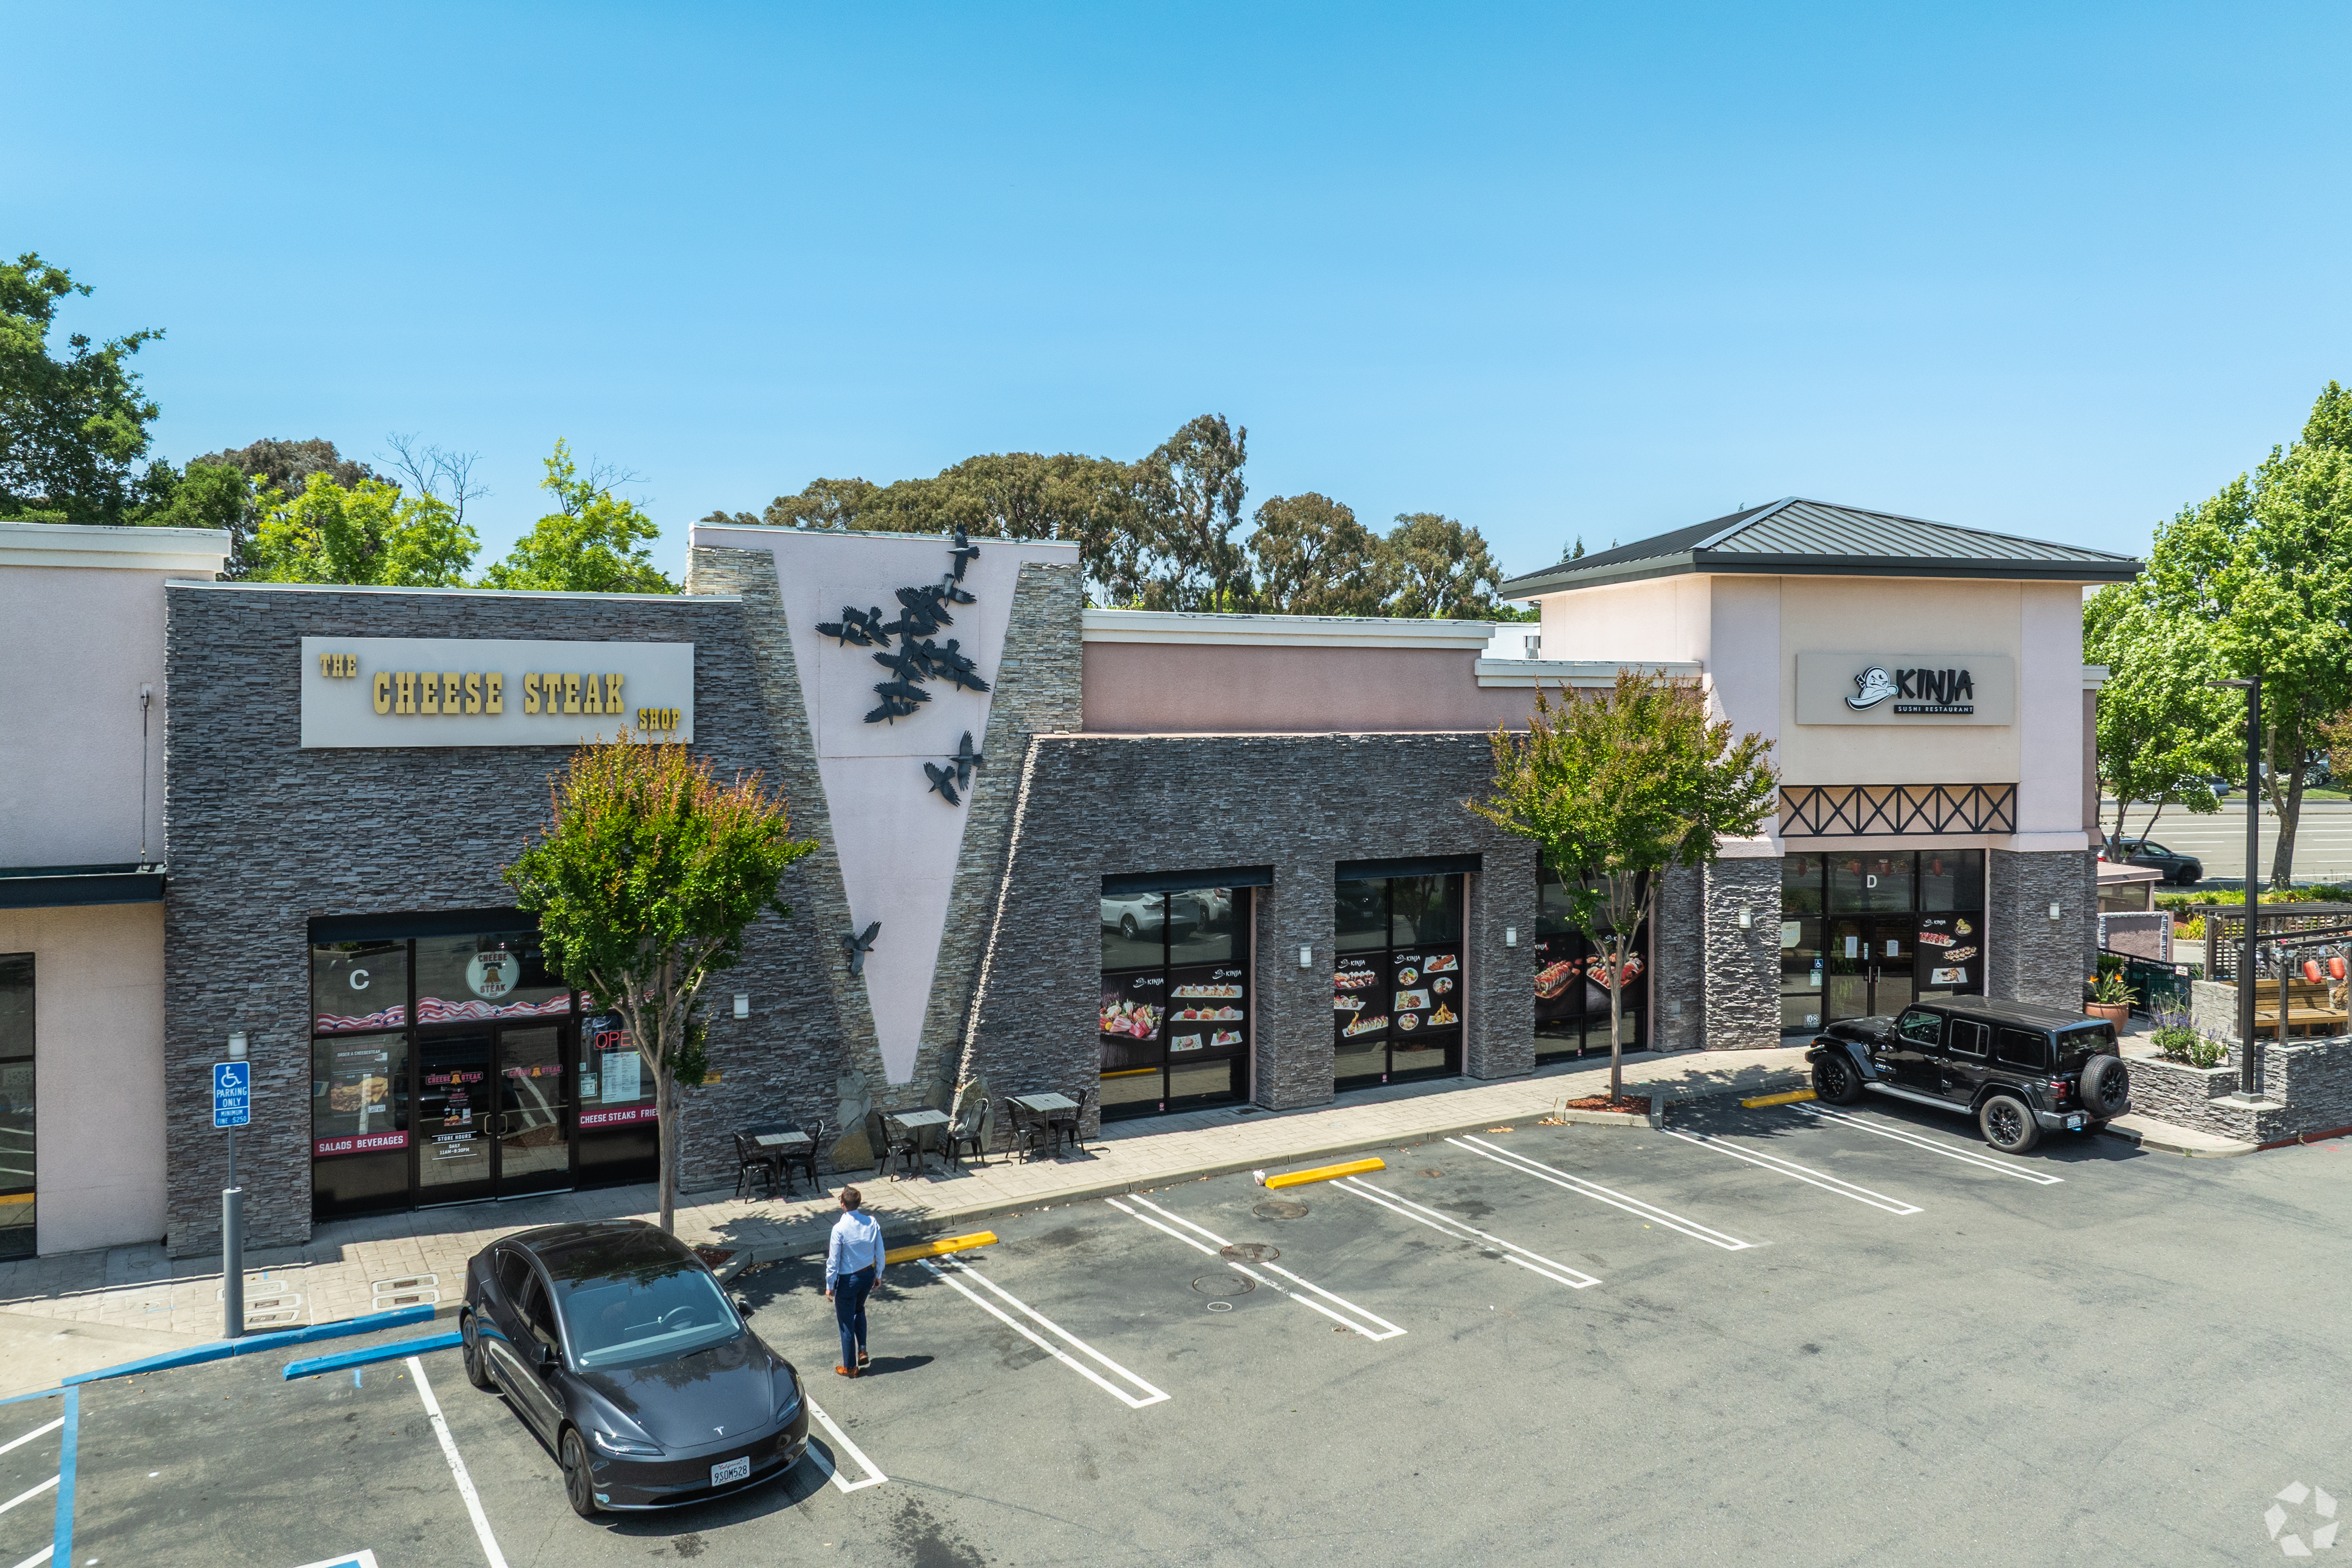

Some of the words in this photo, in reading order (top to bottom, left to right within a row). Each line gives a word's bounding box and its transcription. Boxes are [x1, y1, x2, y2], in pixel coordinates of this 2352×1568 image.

[319, 653, 357, 677] THE
[373, 671, 503, 715] CHEESE
[524, 673, 624, 714] STEAK
[1896, 669, 1975, 705] KINJA
[638, 708, 681, 731] SHOP
[1867, 875, 1877, 888] D
[478, 953, 508, 963] CHEESE
[350, 969, 369, 989] C
[480, 984, 506, 993] STEAK
[596, 1031, 636, 1048] OPE
[216, 1087, 247, 1098] PARKING
[222, 1098, 241, 1107] ONLY
[580, 1114, 607, 1124] CHEESE
[608, 1111, 636, 1121] STEAKS
[319, 1141, 352, 1152] SALADS
[357, 1135, 403, 1148] BEVERAGES
